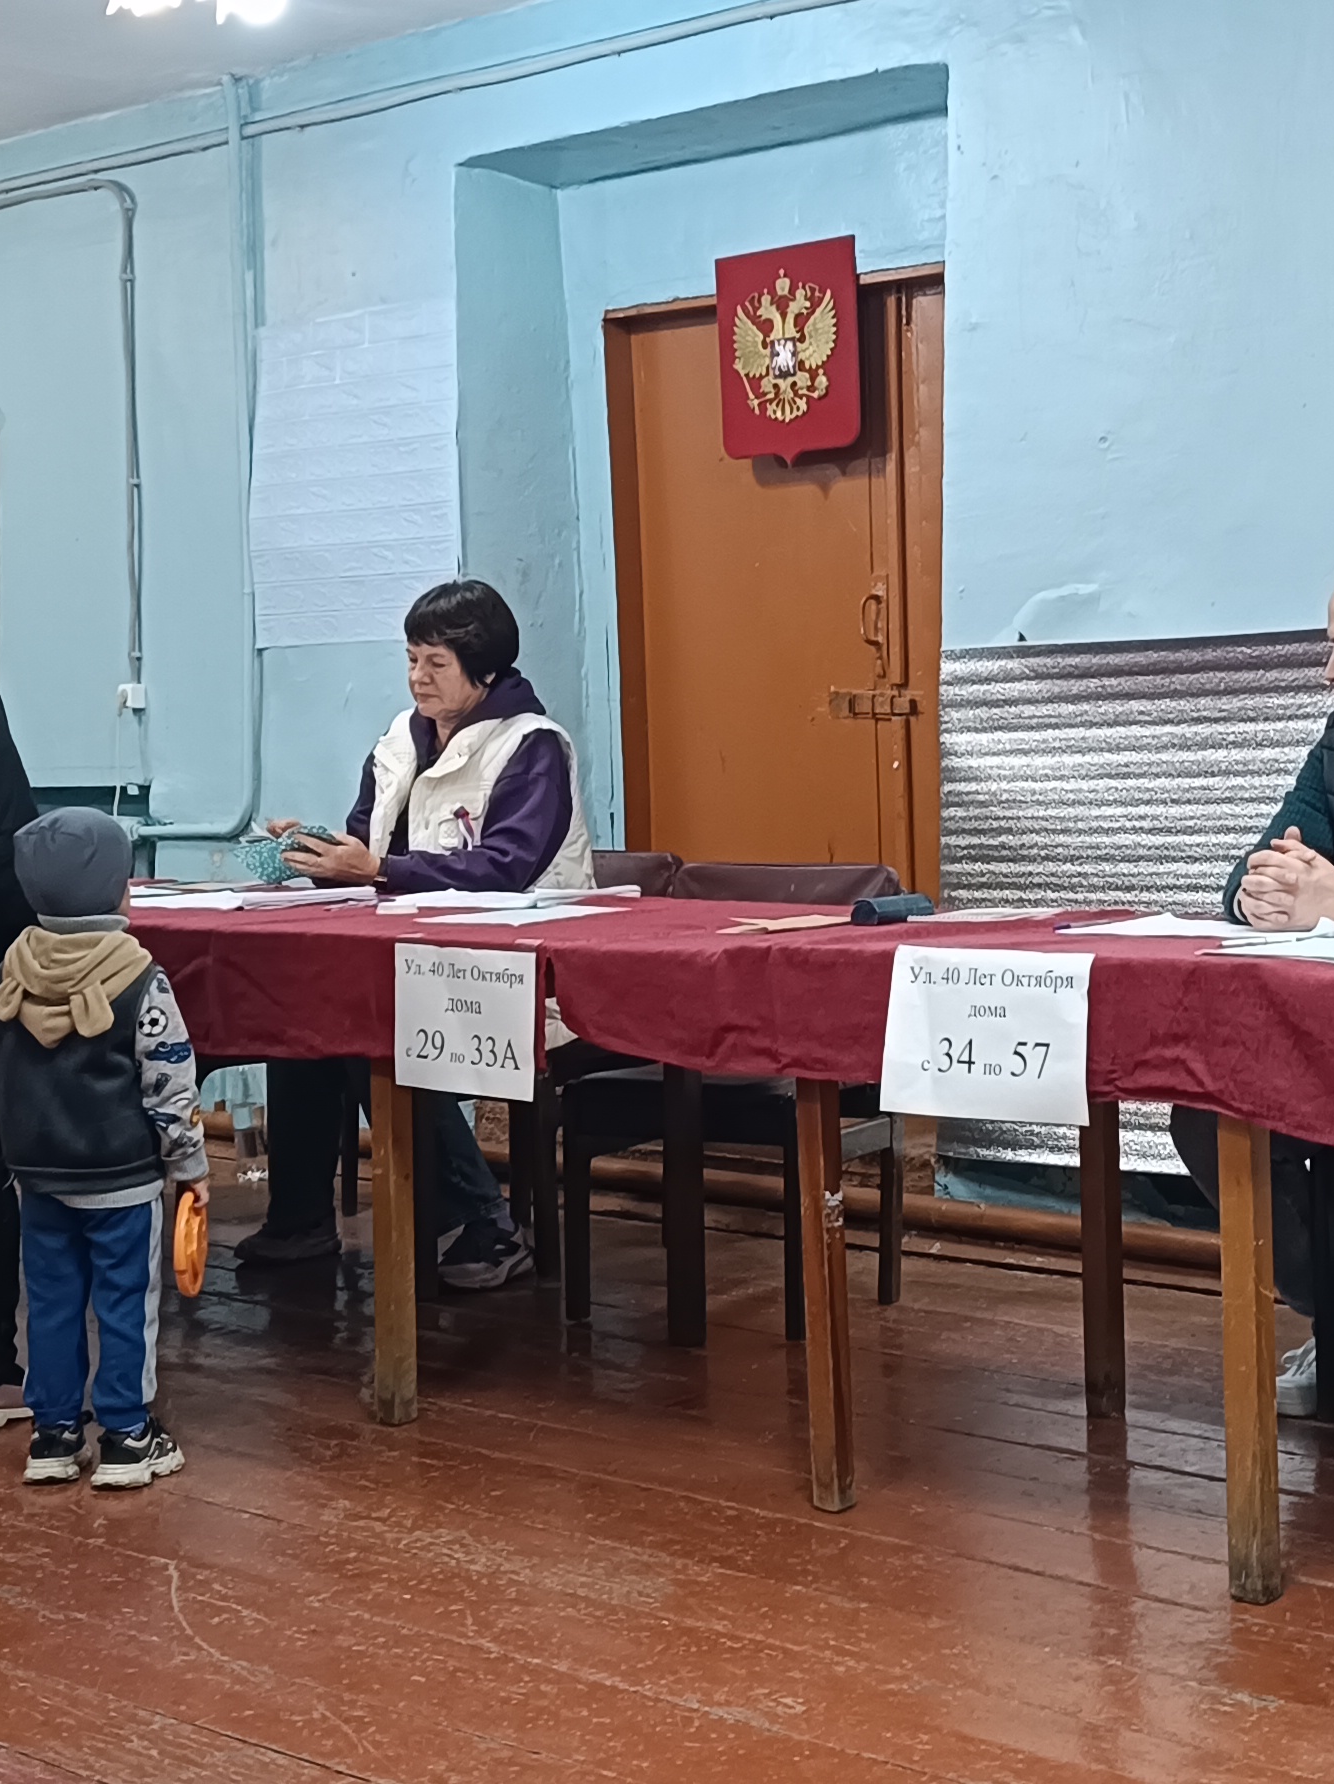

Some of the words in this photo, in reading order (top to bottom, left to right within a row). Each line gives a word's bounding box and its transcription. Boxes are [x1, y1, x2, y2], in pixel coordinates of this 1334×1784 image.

[405, 959, 425, 976] Ул.
[428, 961, 444, 977] 40
[446, 963, 467, 980] Лет
[470, 965, 524, 988] Октября
[909, 966, 936, 984] Ул.
[941, 967, 961, 985] 40
[964, 968, 996, 986] Лет
[1001, 968, 1074, 993] Октября
[444, 998, 482, 1015] дома
[967, 1004, 1006, 1018] дома
[405, 1046, 413, 1058] с
[415, 1028, 445, 1061] 29
[449, 1051, 465, 1064] по
[470, 1034, 521, 1071] 33А
[920, 1059, 931, 1071] с
[937, 1037, 976, 1074] 34
[982, 1062, 1002, 1076] по
[1010, 1041, 1051, 1080] 57
